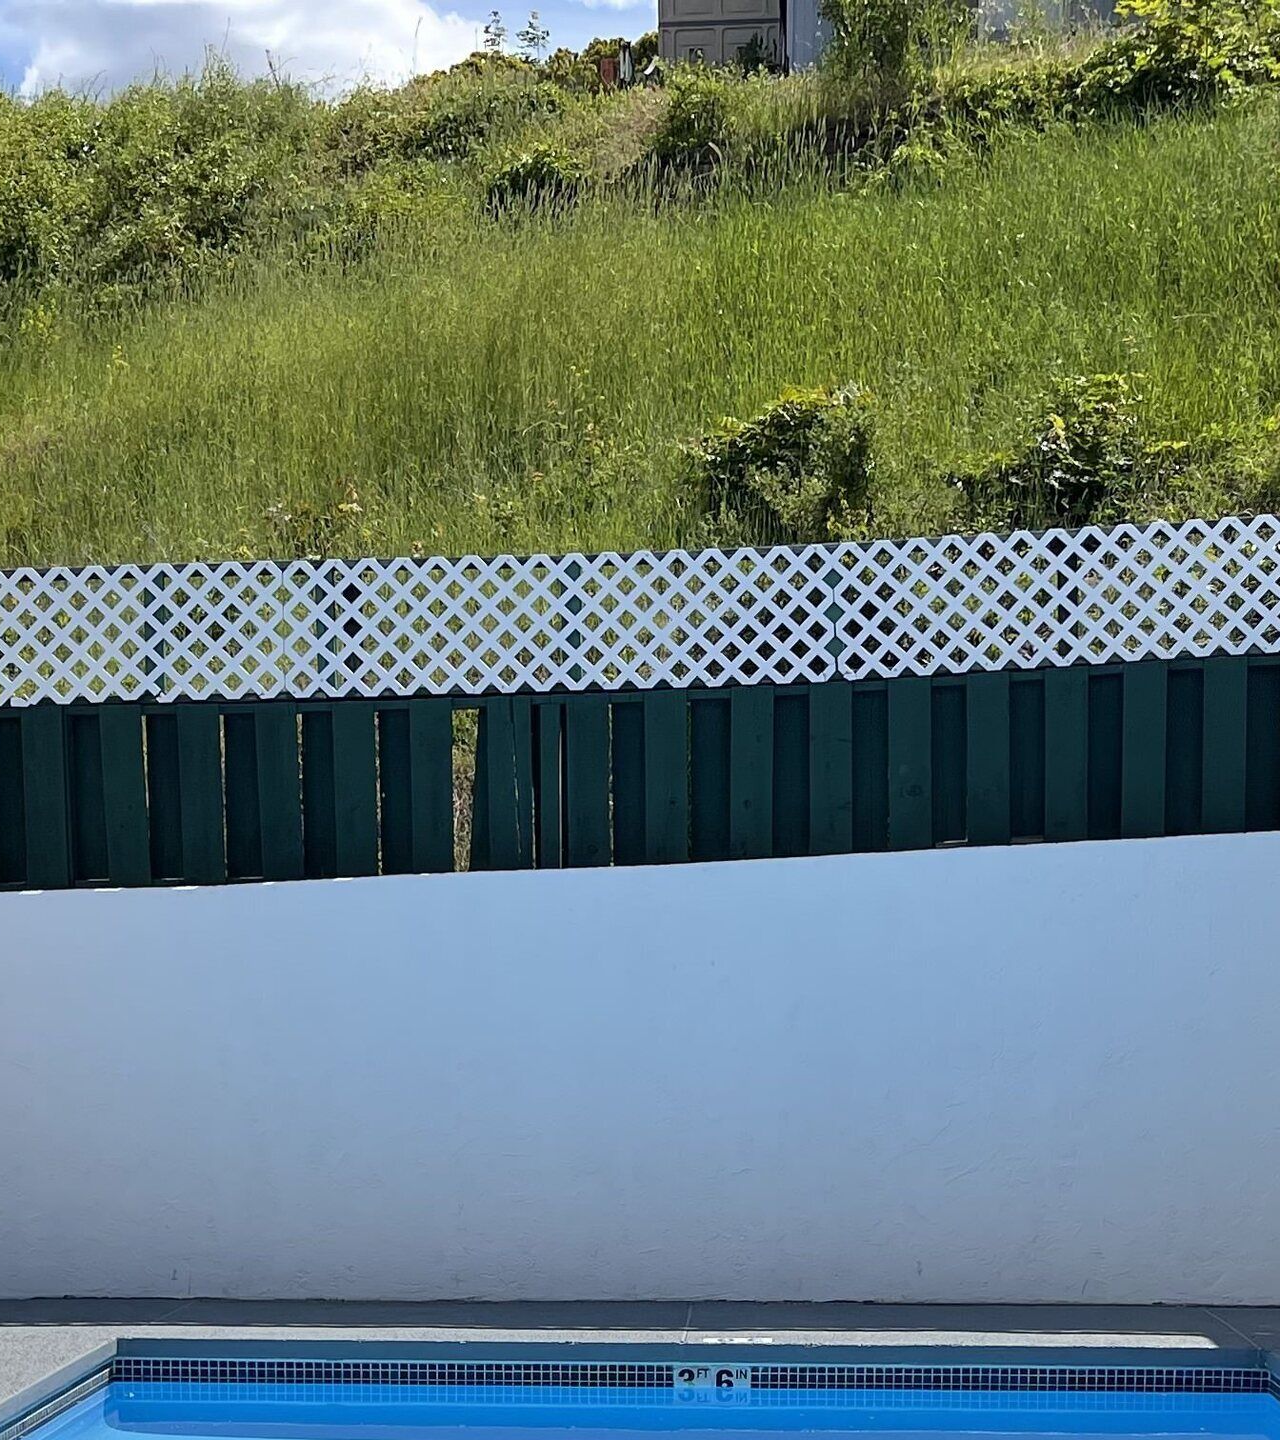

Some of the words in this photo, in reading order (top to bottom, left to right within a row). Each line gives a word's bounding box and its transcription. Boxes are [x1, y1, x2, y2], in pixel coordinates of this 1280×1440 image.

[678, 1368, 695, 1385] 3
[697, 1368, 710, 1378] FT
[715, 1369, 734, 1388] 6
[736, 1369, 748, 1379] IN
